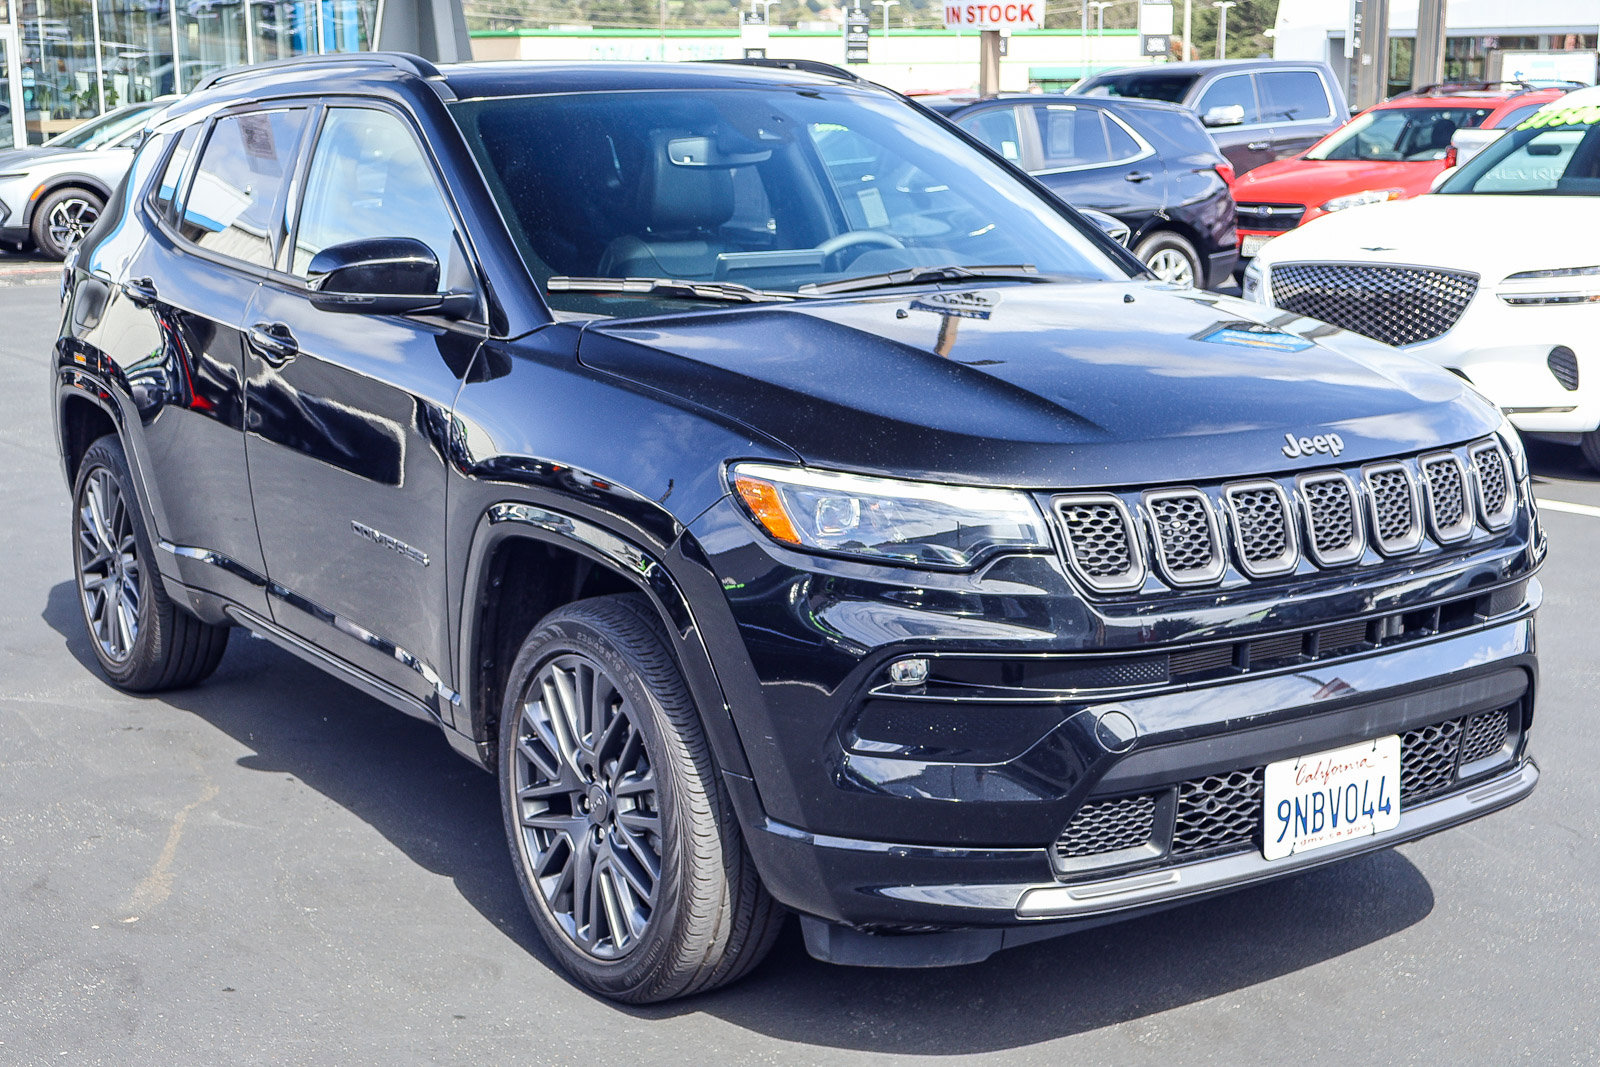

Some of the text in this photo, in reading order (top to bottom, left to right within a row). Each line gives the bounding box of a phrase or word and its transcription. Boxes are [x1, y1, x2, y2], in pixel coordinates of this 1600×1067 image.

[946, 3, 1035, 24] IN STOCK
[1281, 432, 1345, 459] Jeep
[1295, 757, 1375, 786] California
[1277, 775, 1392, 843] 9NBV044
